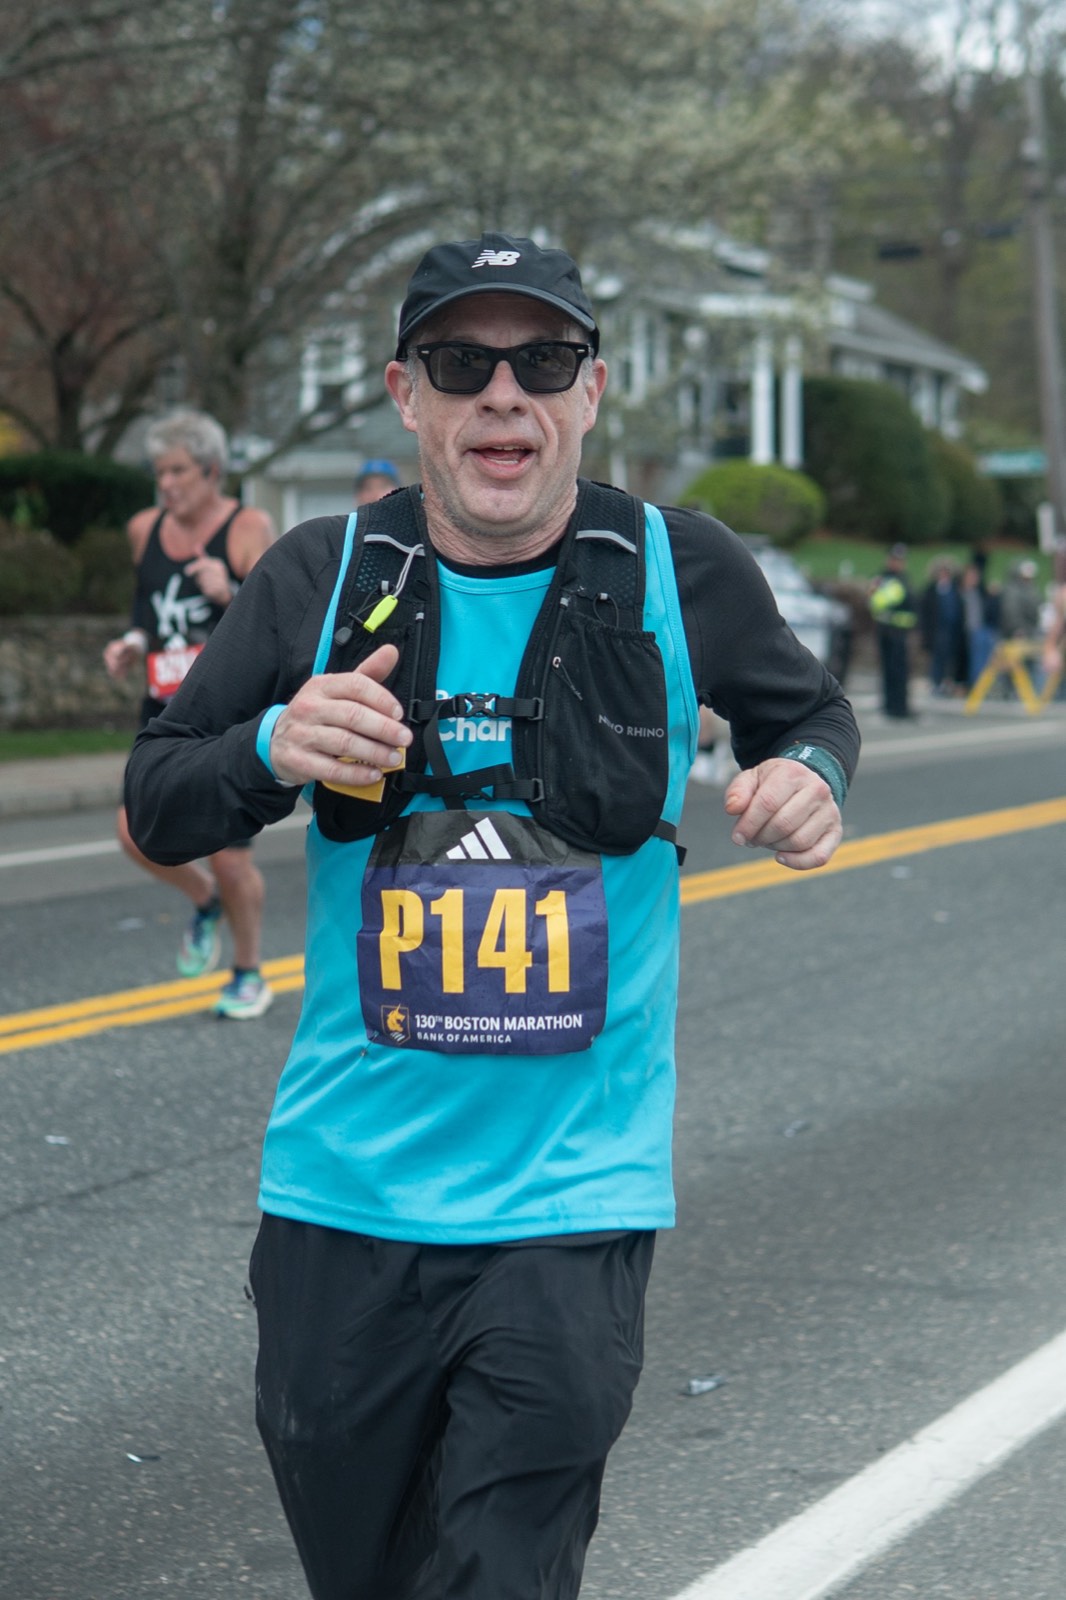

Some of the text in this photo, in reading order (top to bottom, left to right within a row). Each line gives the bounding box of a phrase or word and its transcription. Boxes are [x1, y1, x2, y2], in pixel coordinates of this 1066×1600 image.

[627, 725, 665, 738] RHINO
[379, 888, 570, 993] P141
[415, 1014, 583, 1031] 130TH BOSTON MARATHON
[416, 1031, 512, 1044] BANK OF AMERICA
